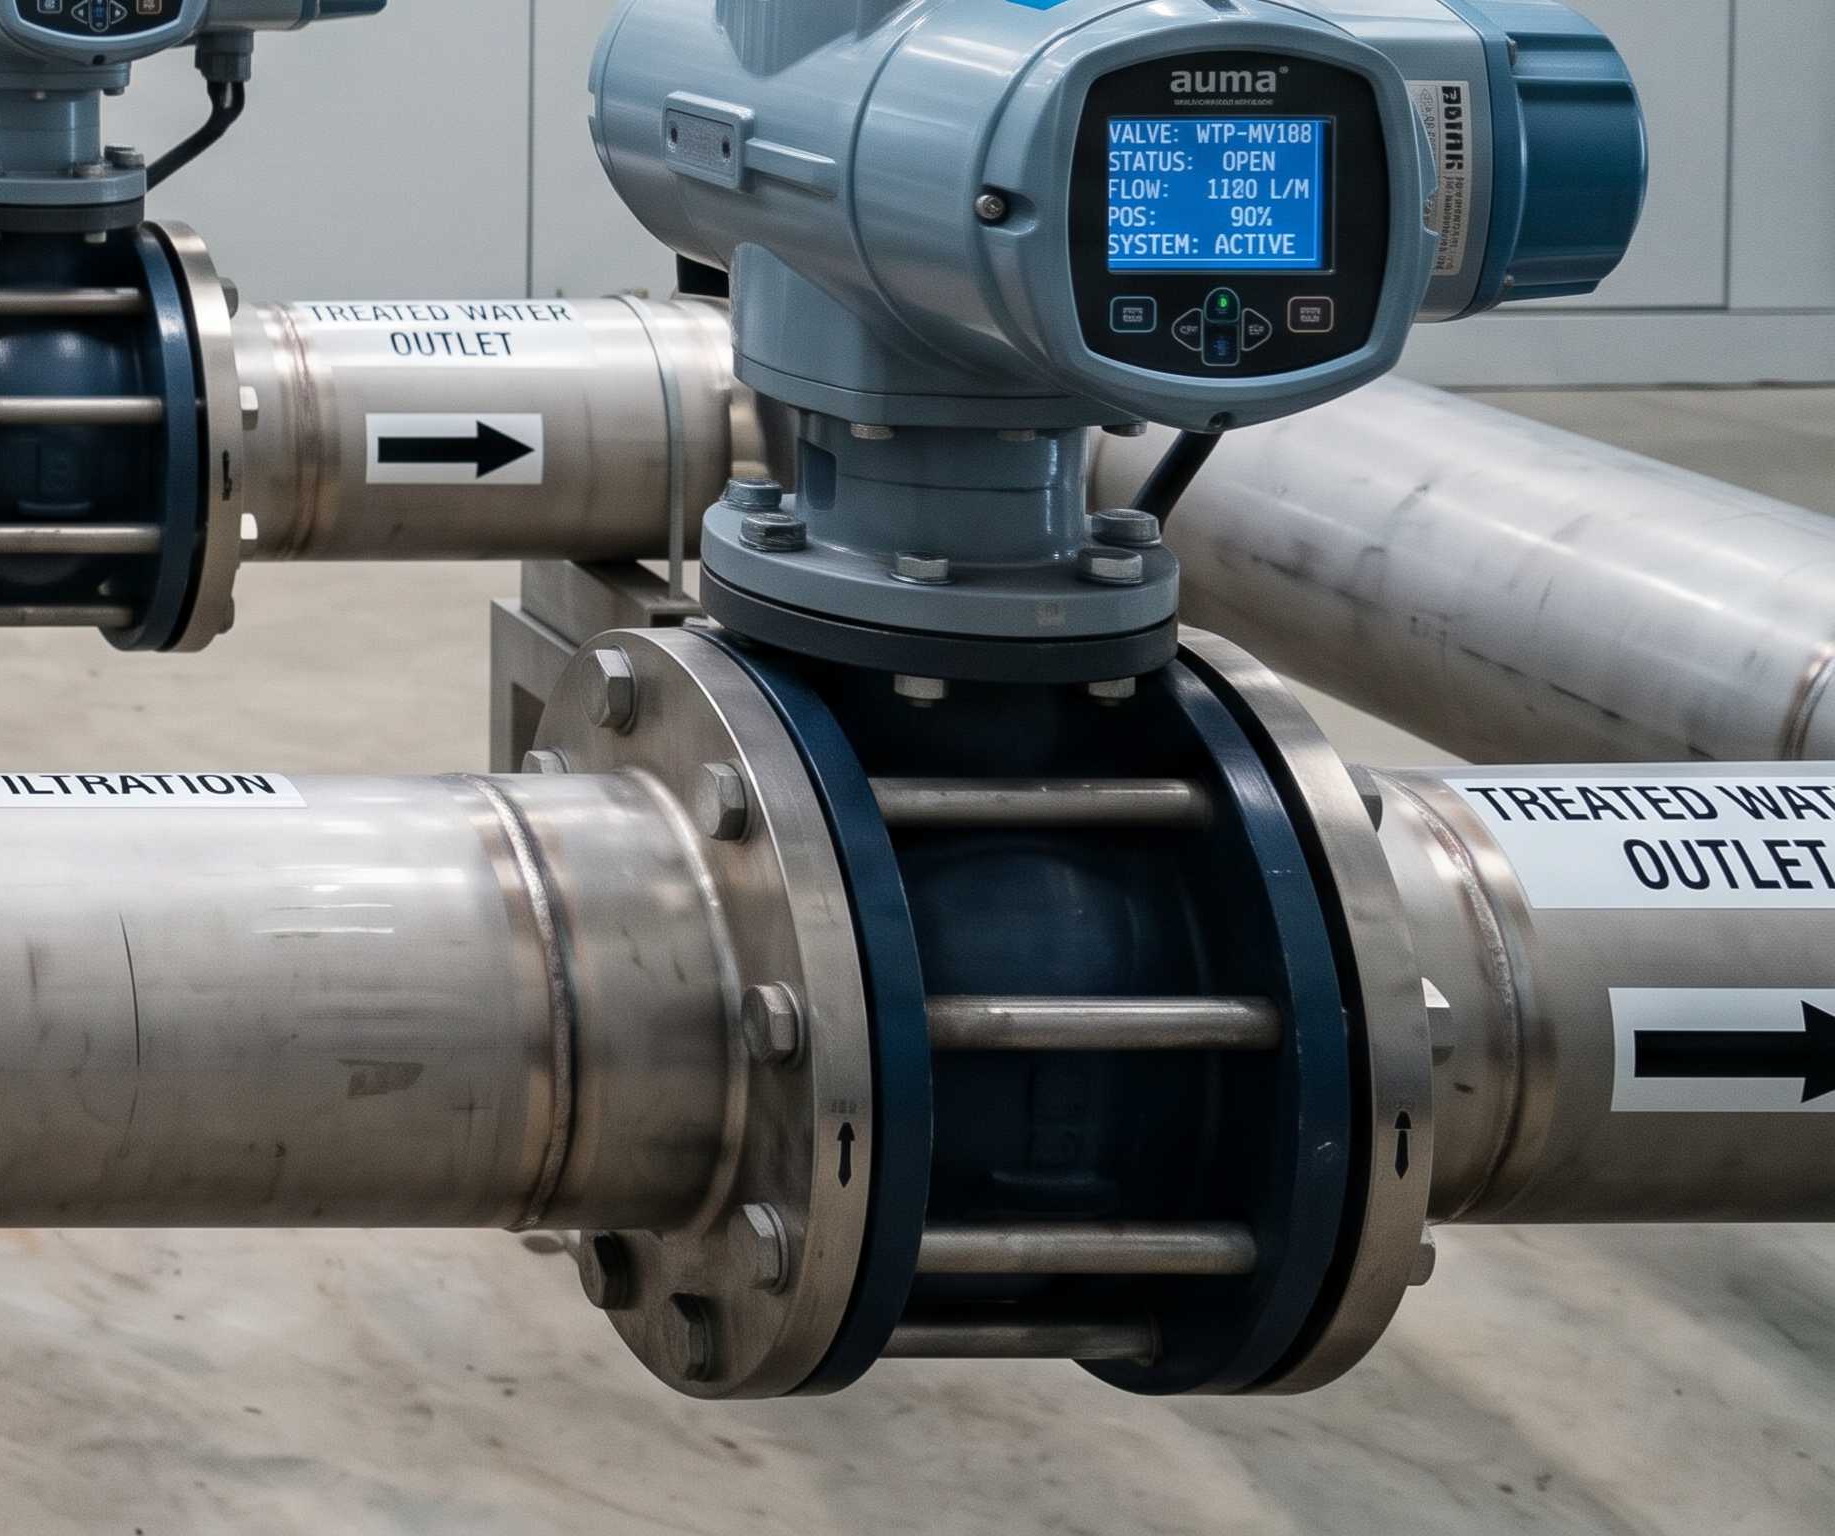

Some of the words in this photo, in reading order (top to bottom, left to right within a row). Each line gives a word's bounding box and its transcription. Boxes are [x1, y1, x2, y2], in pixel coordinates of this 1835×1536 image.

[1171, 70, 1276, 93] auma
[1109, 124, 1179, 144] VALVE:
[1108, 151, 1193, 172] STATUS:
[1222, 151, 1276, 172] OPEN
[1108, 178, 1169, 200] FLOW:
[1270, 178, 1310, 200] L/M
[1108, 206, 1156, 227] POS:
[1230, 206, 1273, 228] 90%
[1108, 233, 1199, 255] SYSTEM:
[1214, 233, 1296, 255] ACTIVE
[308, 303, 450, 322] TREATED
[454, 303, 572, 323] WATER
[390, 330, 514, 358] OUTLET
[1465, 785, 1718, 821] TREATED
[1715, 785, 1835, 821] WAT
[1622, 838, 1835, 890] OUTLET
